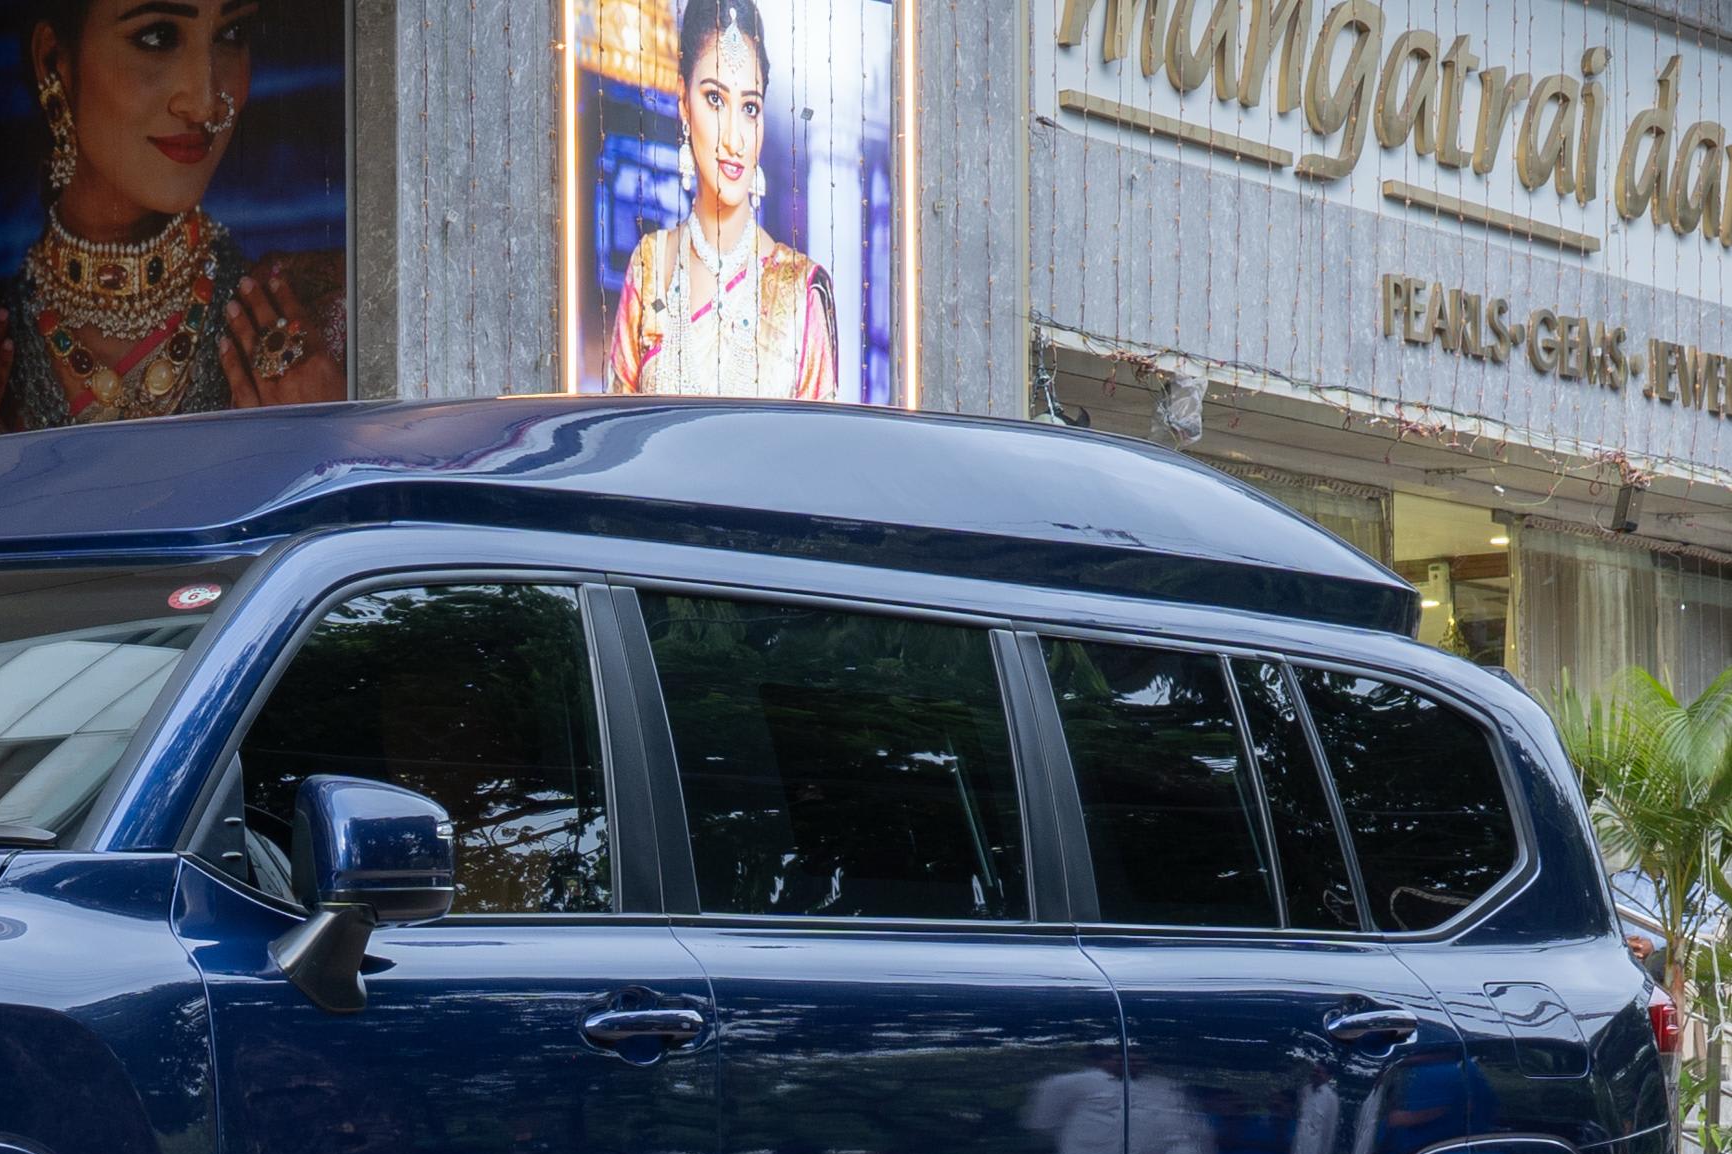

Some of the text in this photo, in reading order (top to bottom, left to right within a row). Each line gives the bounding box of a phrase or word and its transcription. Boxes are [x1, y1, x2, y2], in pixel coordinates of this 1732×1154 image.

[1614, 54, 1732, 248] da
[1382, 273, 1511, 364] PEARLS
[1527, 309, 1629, 390] GEMS
